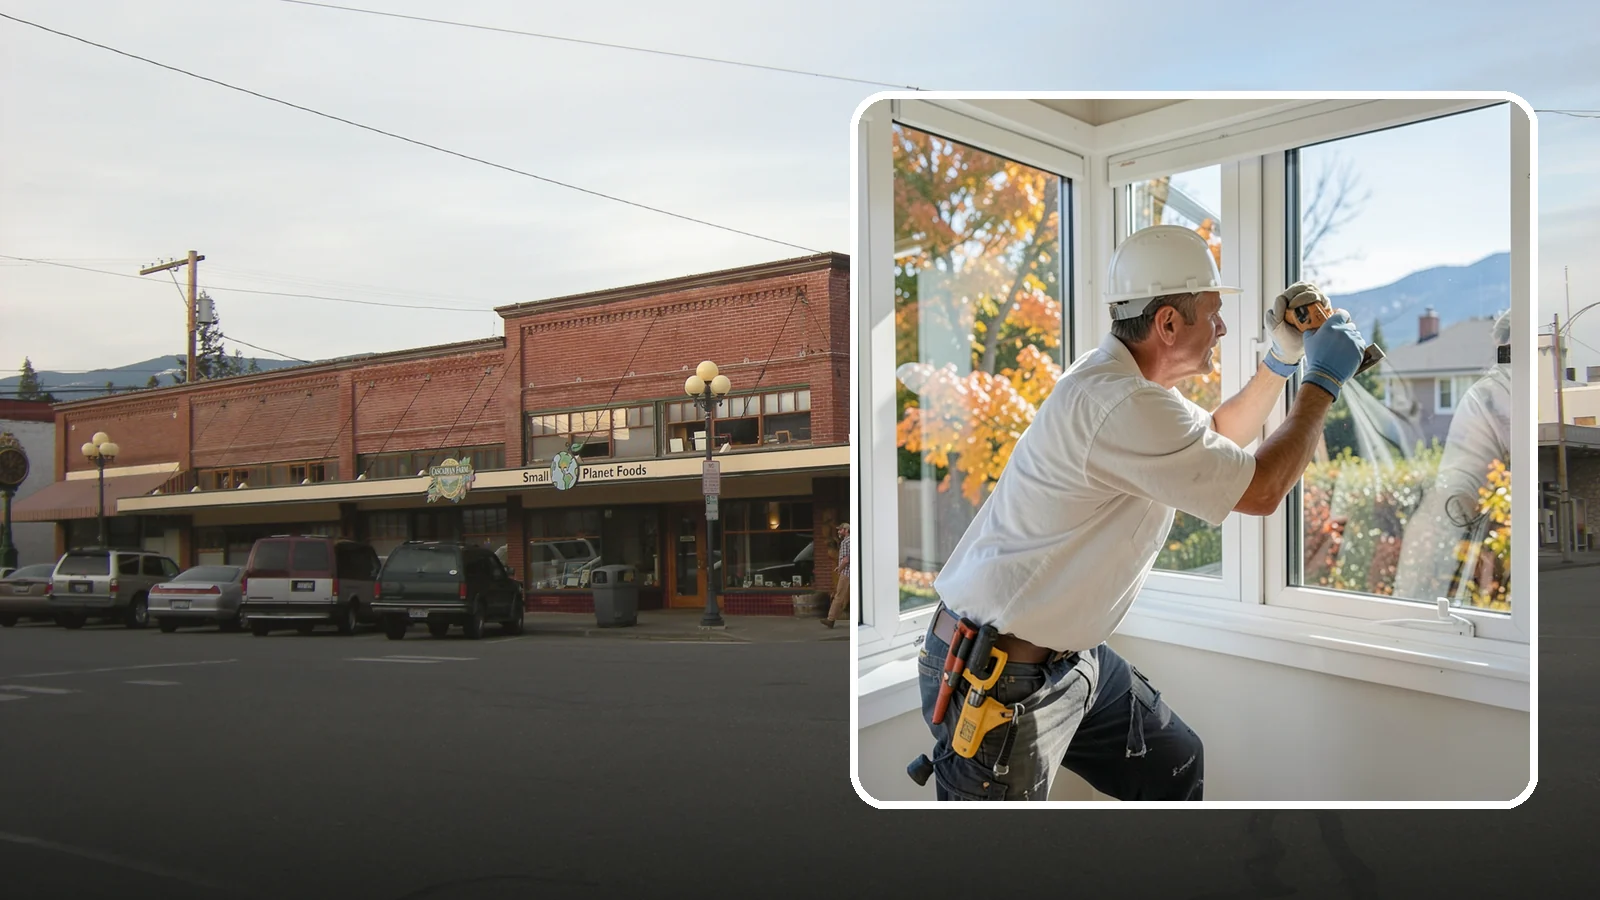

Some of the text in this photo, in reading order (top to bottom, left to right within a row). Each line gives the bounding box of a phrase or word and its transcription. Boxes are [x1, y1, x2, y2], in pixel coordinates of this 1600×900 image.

[523, 464, 647, 482] Small Planet Foods
